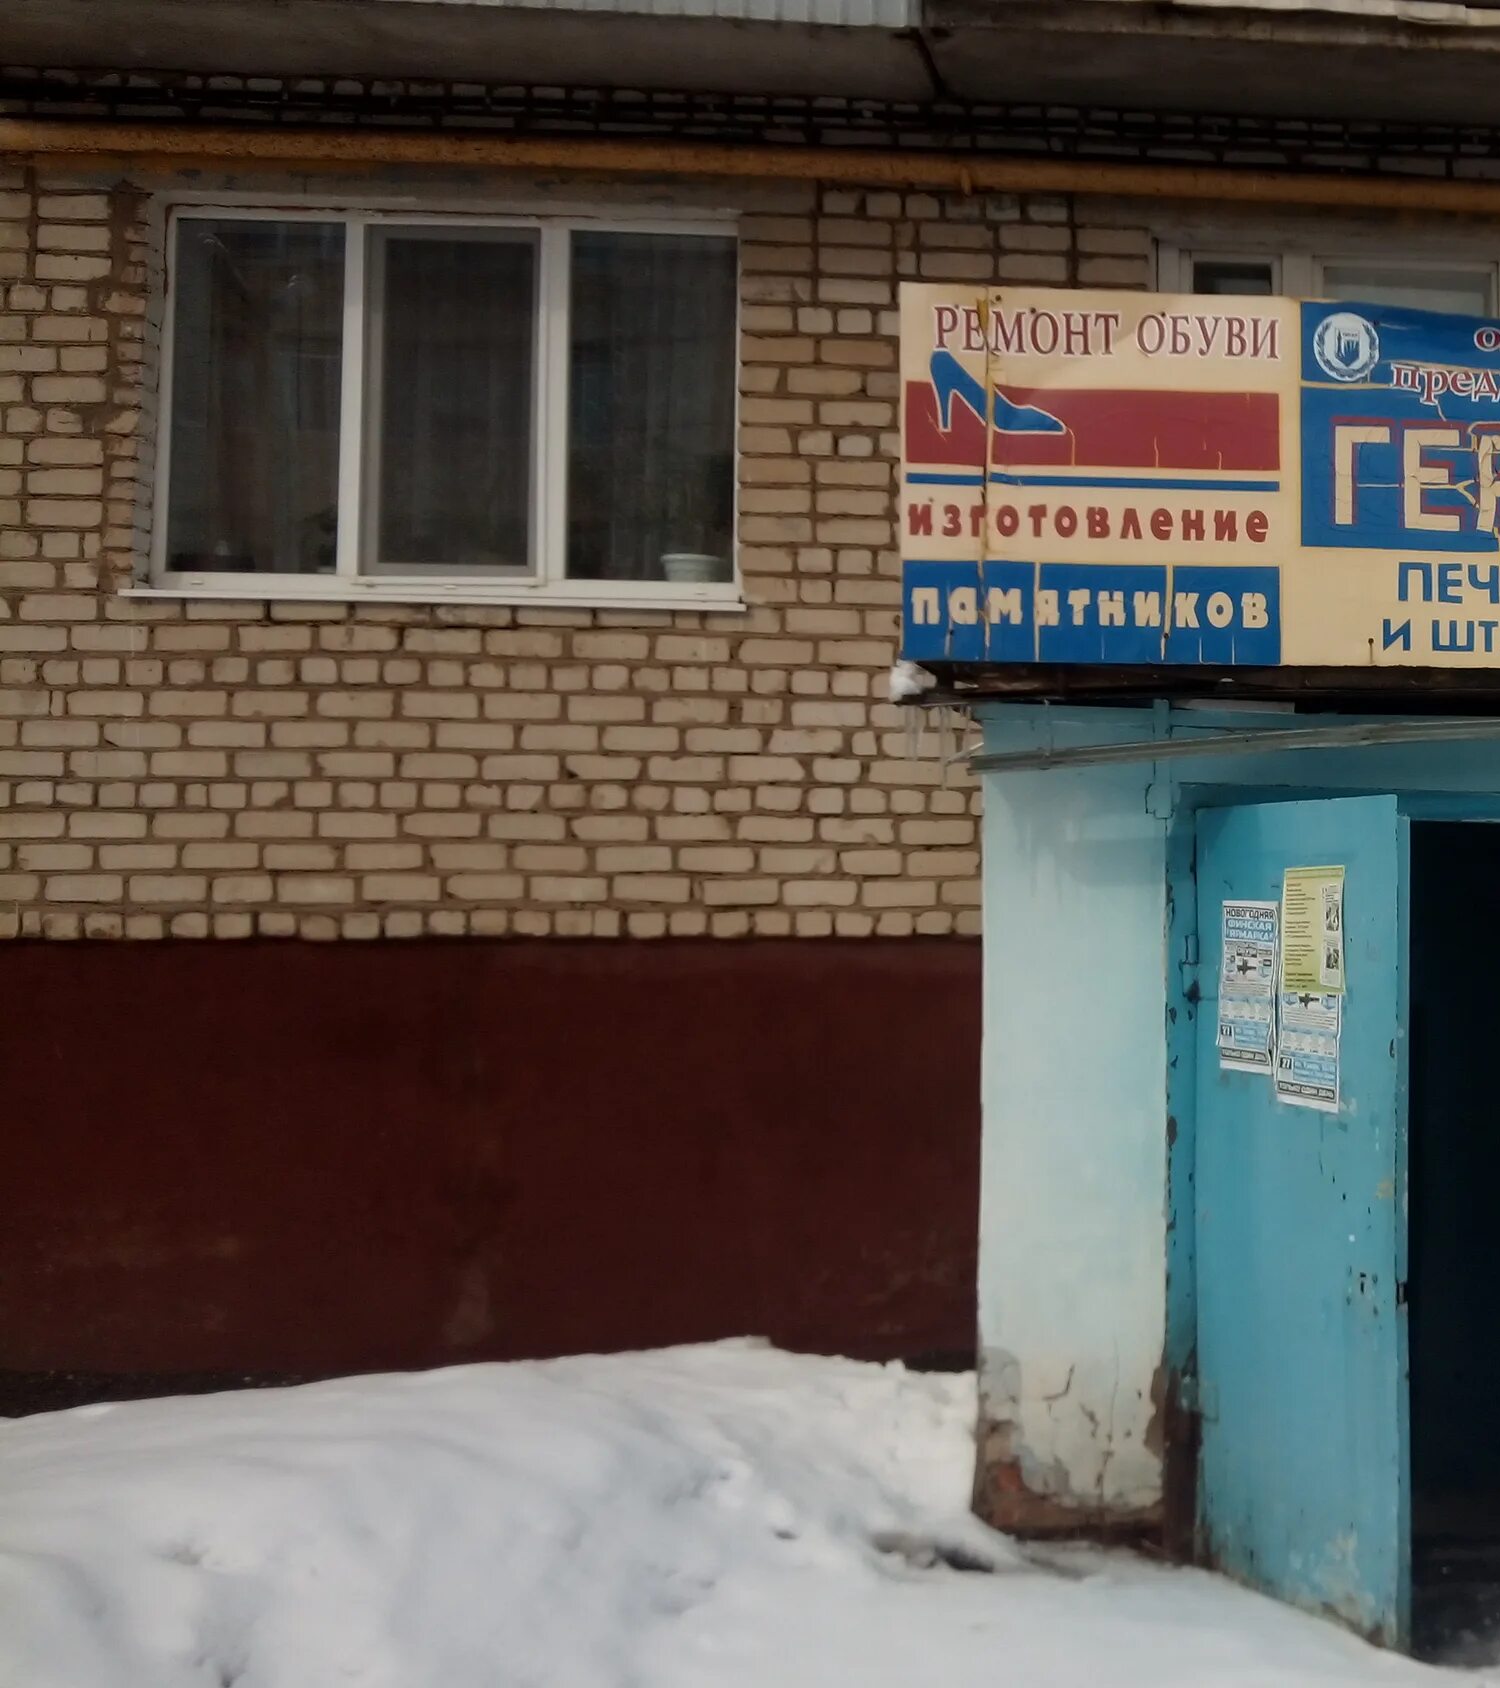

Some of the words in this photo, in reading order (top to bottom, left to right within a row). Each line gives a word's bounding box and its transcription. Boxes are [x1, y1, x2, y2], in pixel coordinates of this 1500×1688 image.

[934, 306, 1119, 356] РЕМОНТ
[1137, 313, 1281, 360] ОБУВИ
[1382, 618, 1411, 651] И
